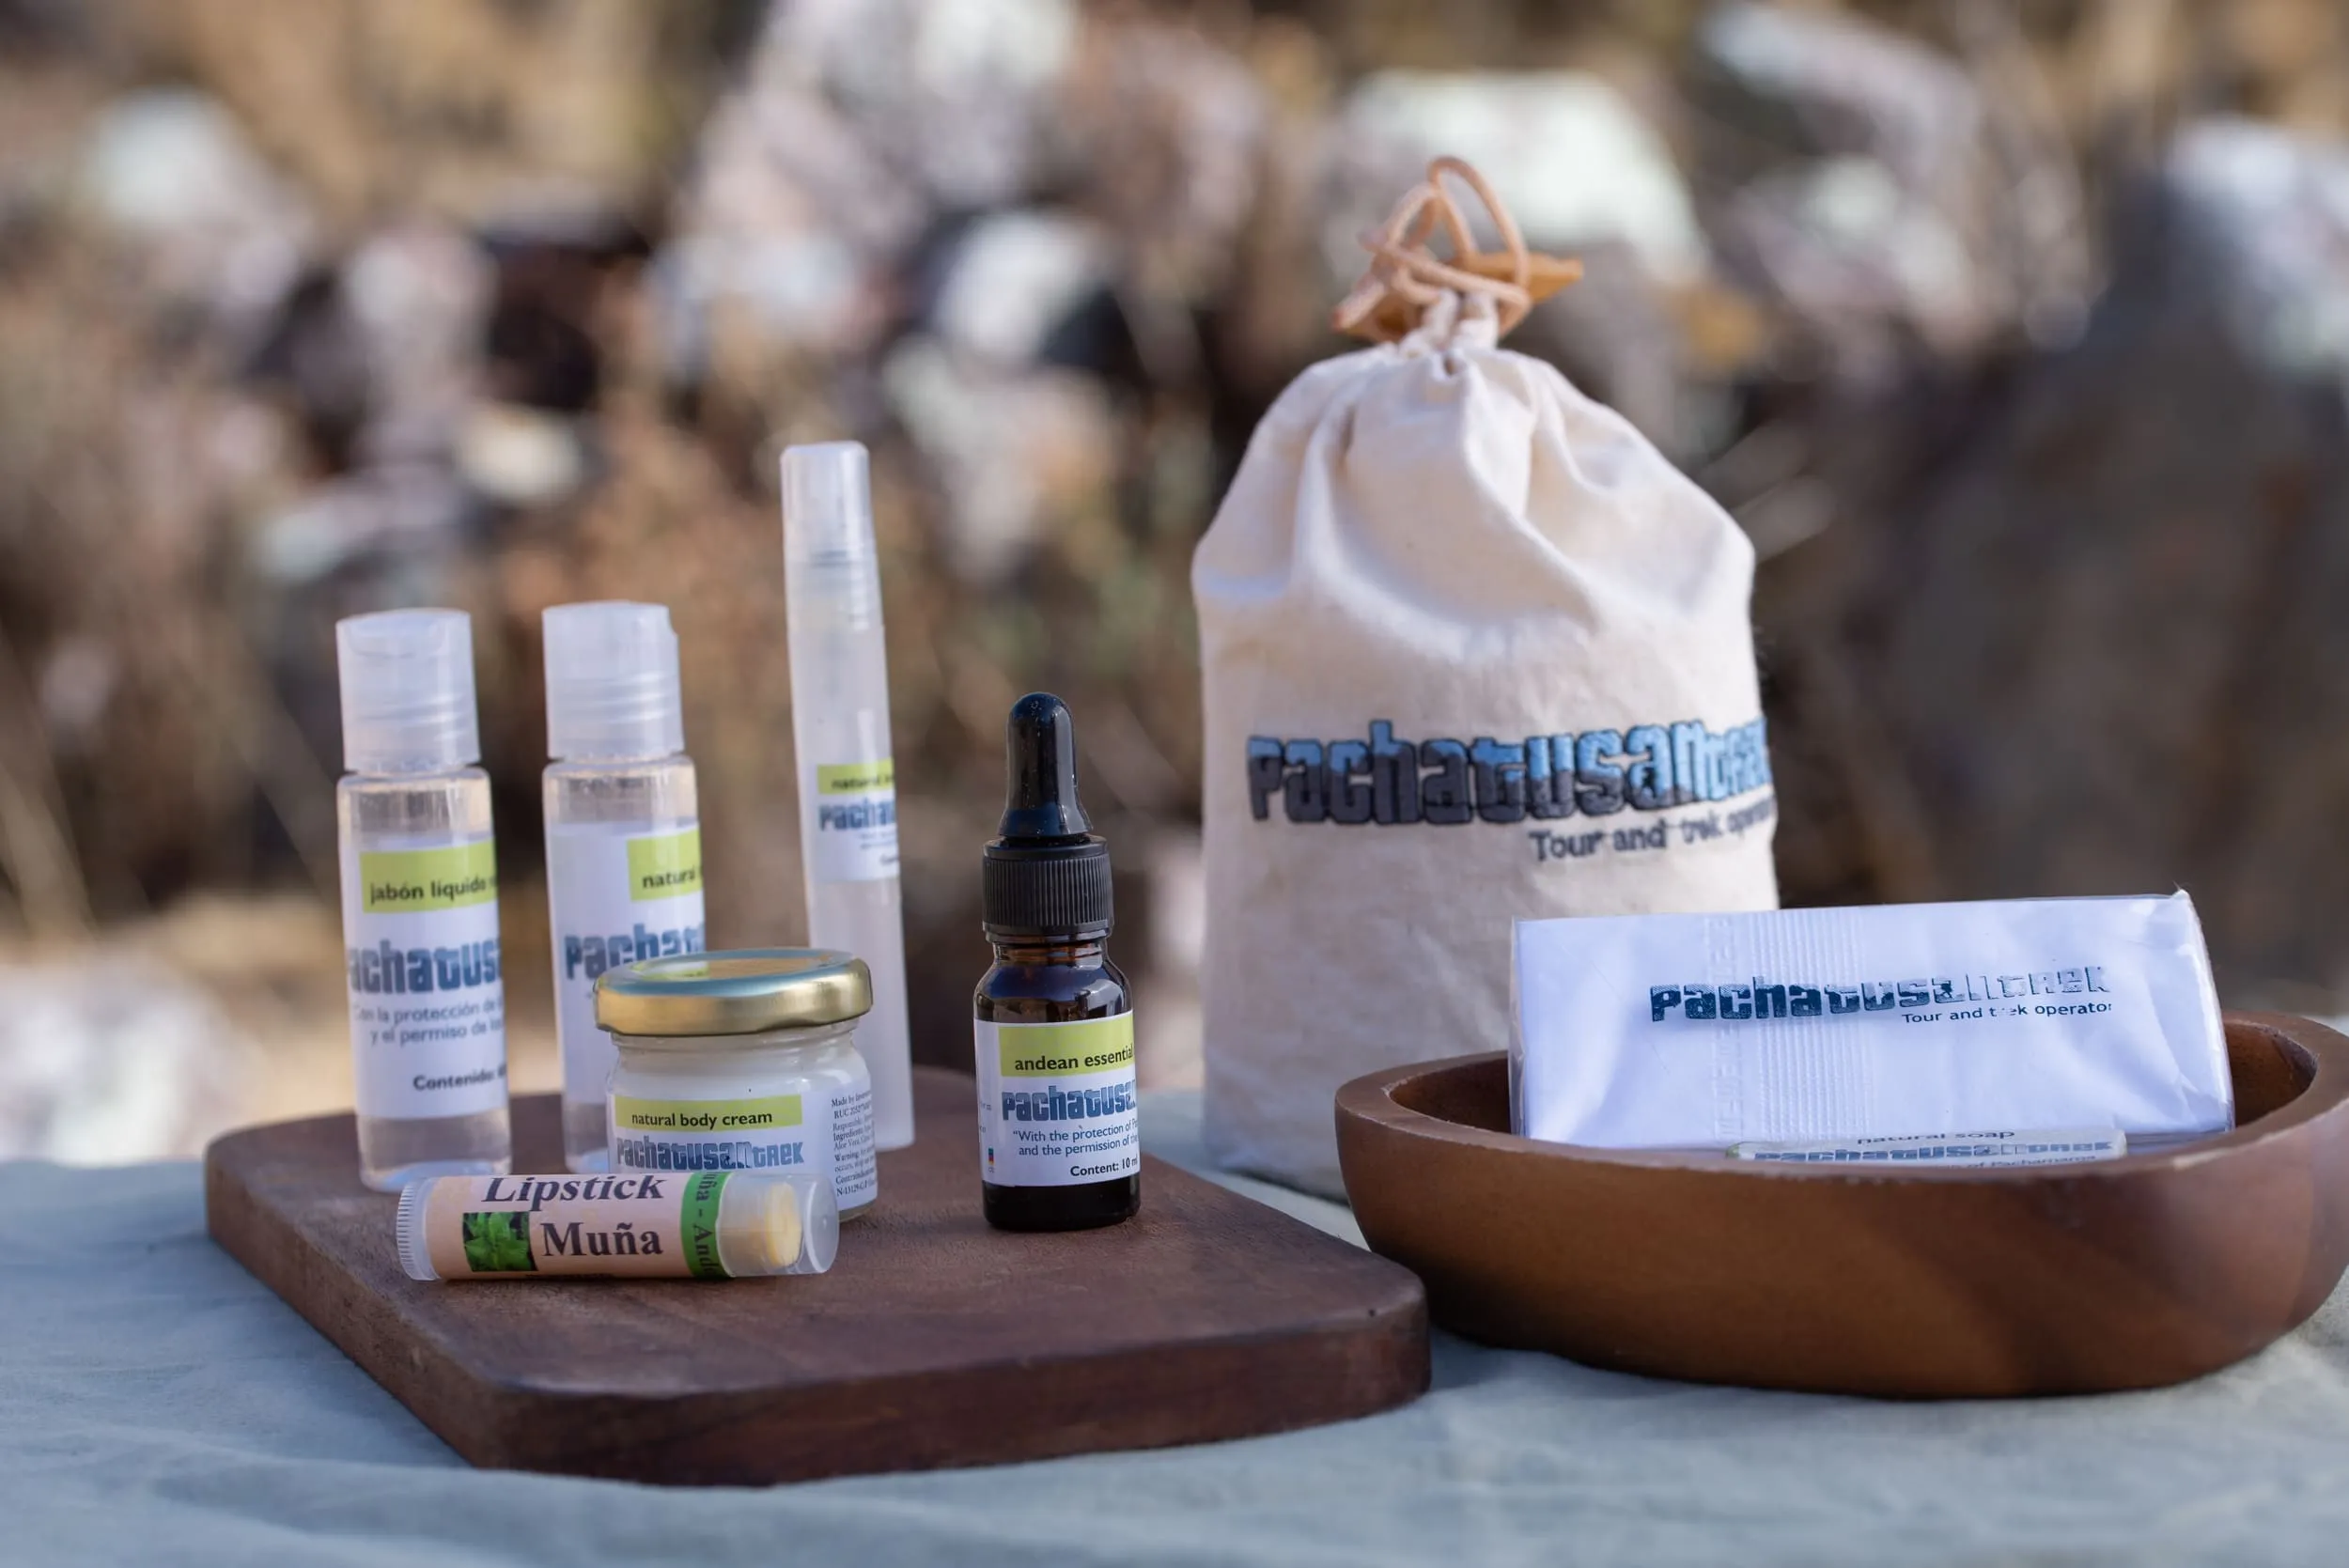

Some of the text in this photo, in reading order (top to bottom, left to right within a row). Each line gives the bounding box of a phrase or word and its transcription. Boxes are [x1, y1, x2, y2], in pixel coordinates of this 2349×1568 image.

[1530, 829, 1603, 862] Tour
[1612, 816, 1668, 852] and
[370, 880, 424, 906] jabón
[1902, 1012, 1942, 1024] Tour
[1950, 1007, 1983, 1020] and
[1990, 1003, 2028, 1017] tek
[400, 1025, 467, 1048] permiso
[472, 1019, 486, 1035] de
[1015, 1045, 1134, 1071] andean essential
[631, 1112, 772, 1130] natural body cream
[1050, 1129, 1069, 1141] the
[1073, 1124, 1124, 1142] protection
[1019, 1143, 1039, 1157] and
[1042, 1143, 1062, 1156] the
[1066, 1140, 1121, 1157] permission
[1123, 1134, 1129, 1146] of
[1858, 1131, 2015, 1144] natural soap
[1070, 1162, 1119, 1176] Content:
[1122, 1157, 1130, 1170] 10
[481, 1175, 666, 1212] Lipstick
[540, 1222, 663, 1256] Muña
